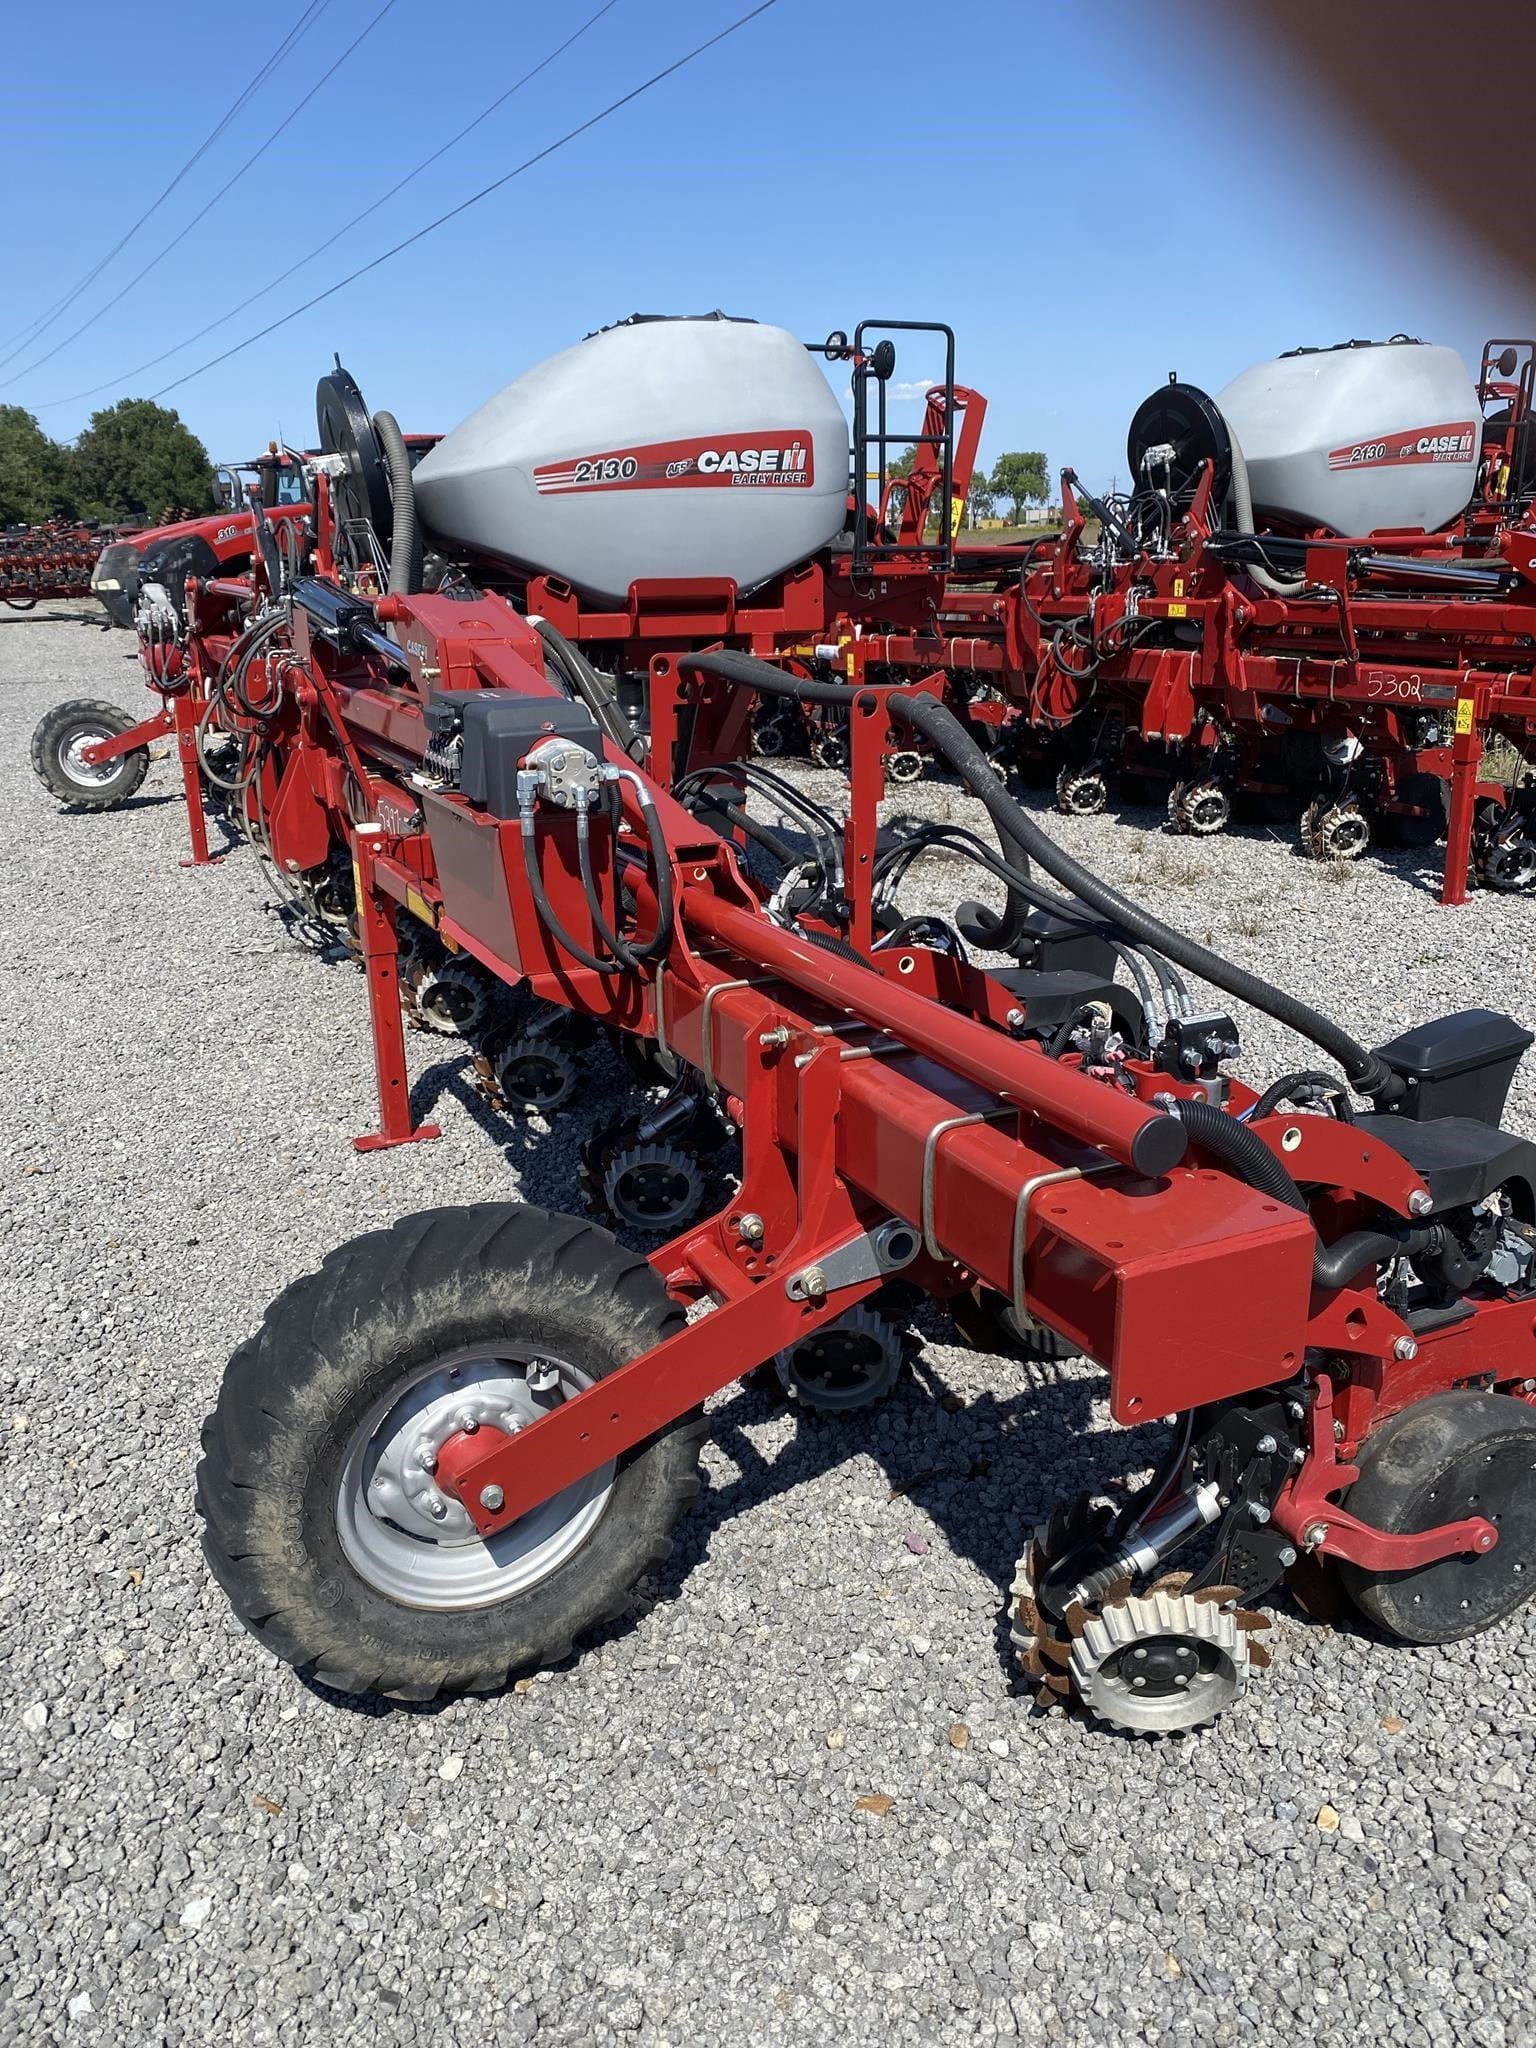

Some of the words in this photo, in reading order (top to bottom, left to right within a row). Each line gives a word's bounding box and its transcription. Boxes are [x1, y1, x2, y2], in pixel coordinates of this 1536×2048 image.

[1351, 443, 1386, 463] 2130
[1417, 436, 1459, 453] CASE
[575, 457, 637, 482] 2130
[698, 450, 778, 474] CASE
[731, 473, 772, 485] EARLY
[773, 472, 807, 484] RISER
[1368, 671, 1421, 701] 5302
